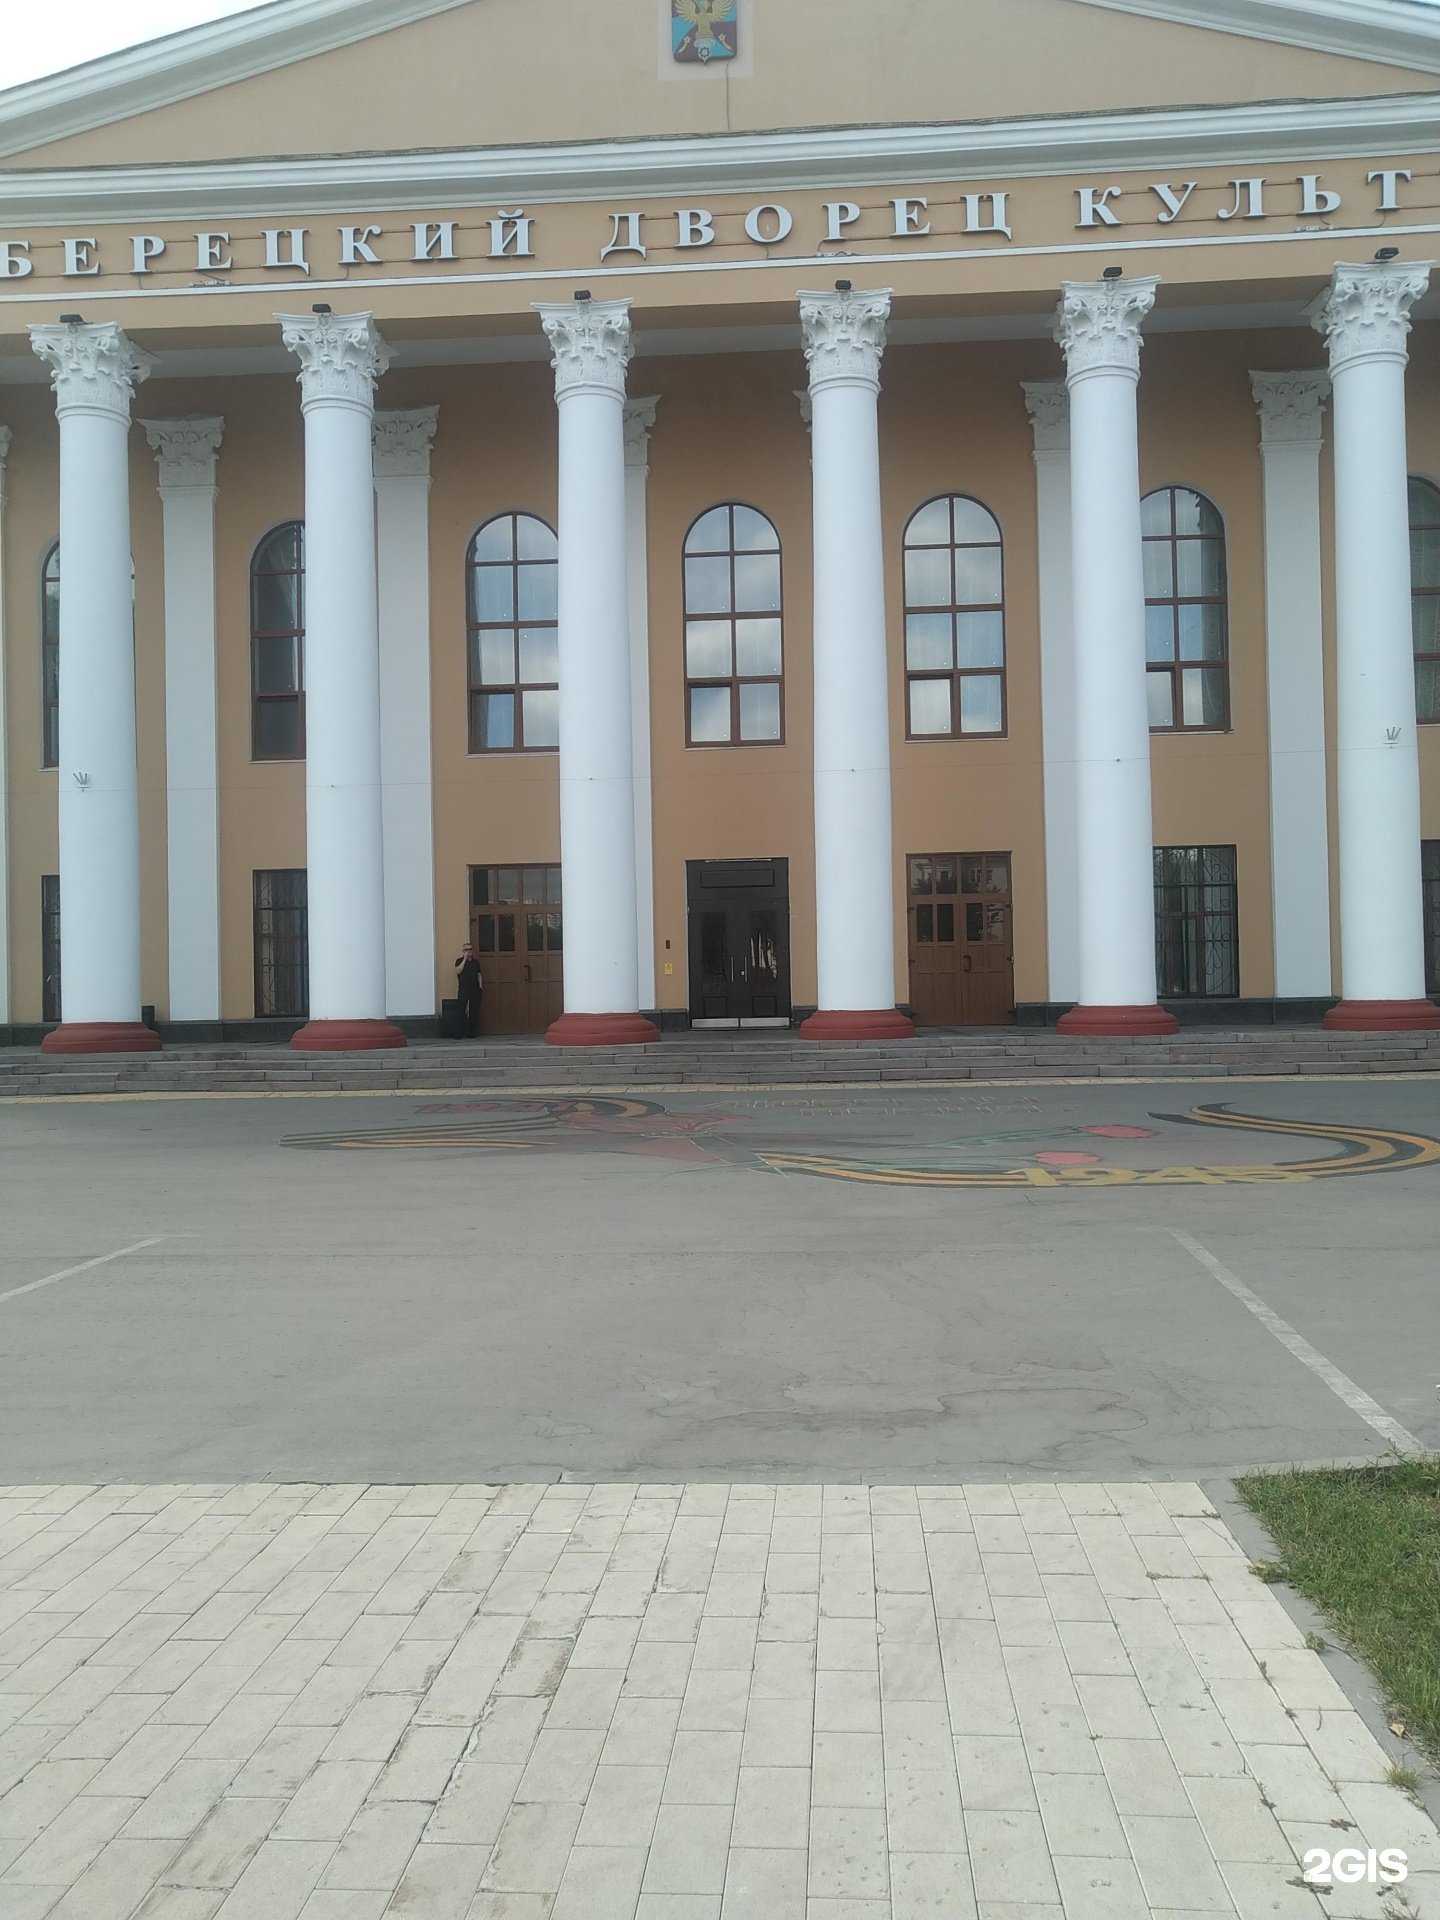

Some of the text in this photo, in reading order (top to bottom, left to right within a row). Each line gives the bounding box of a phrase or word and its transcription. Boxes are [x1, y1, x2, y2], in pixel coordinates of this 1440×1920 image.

[0, 168, 1412, 279] БЕРЕЦКИЙ ДВОРЕЦ КУЛЬТ
